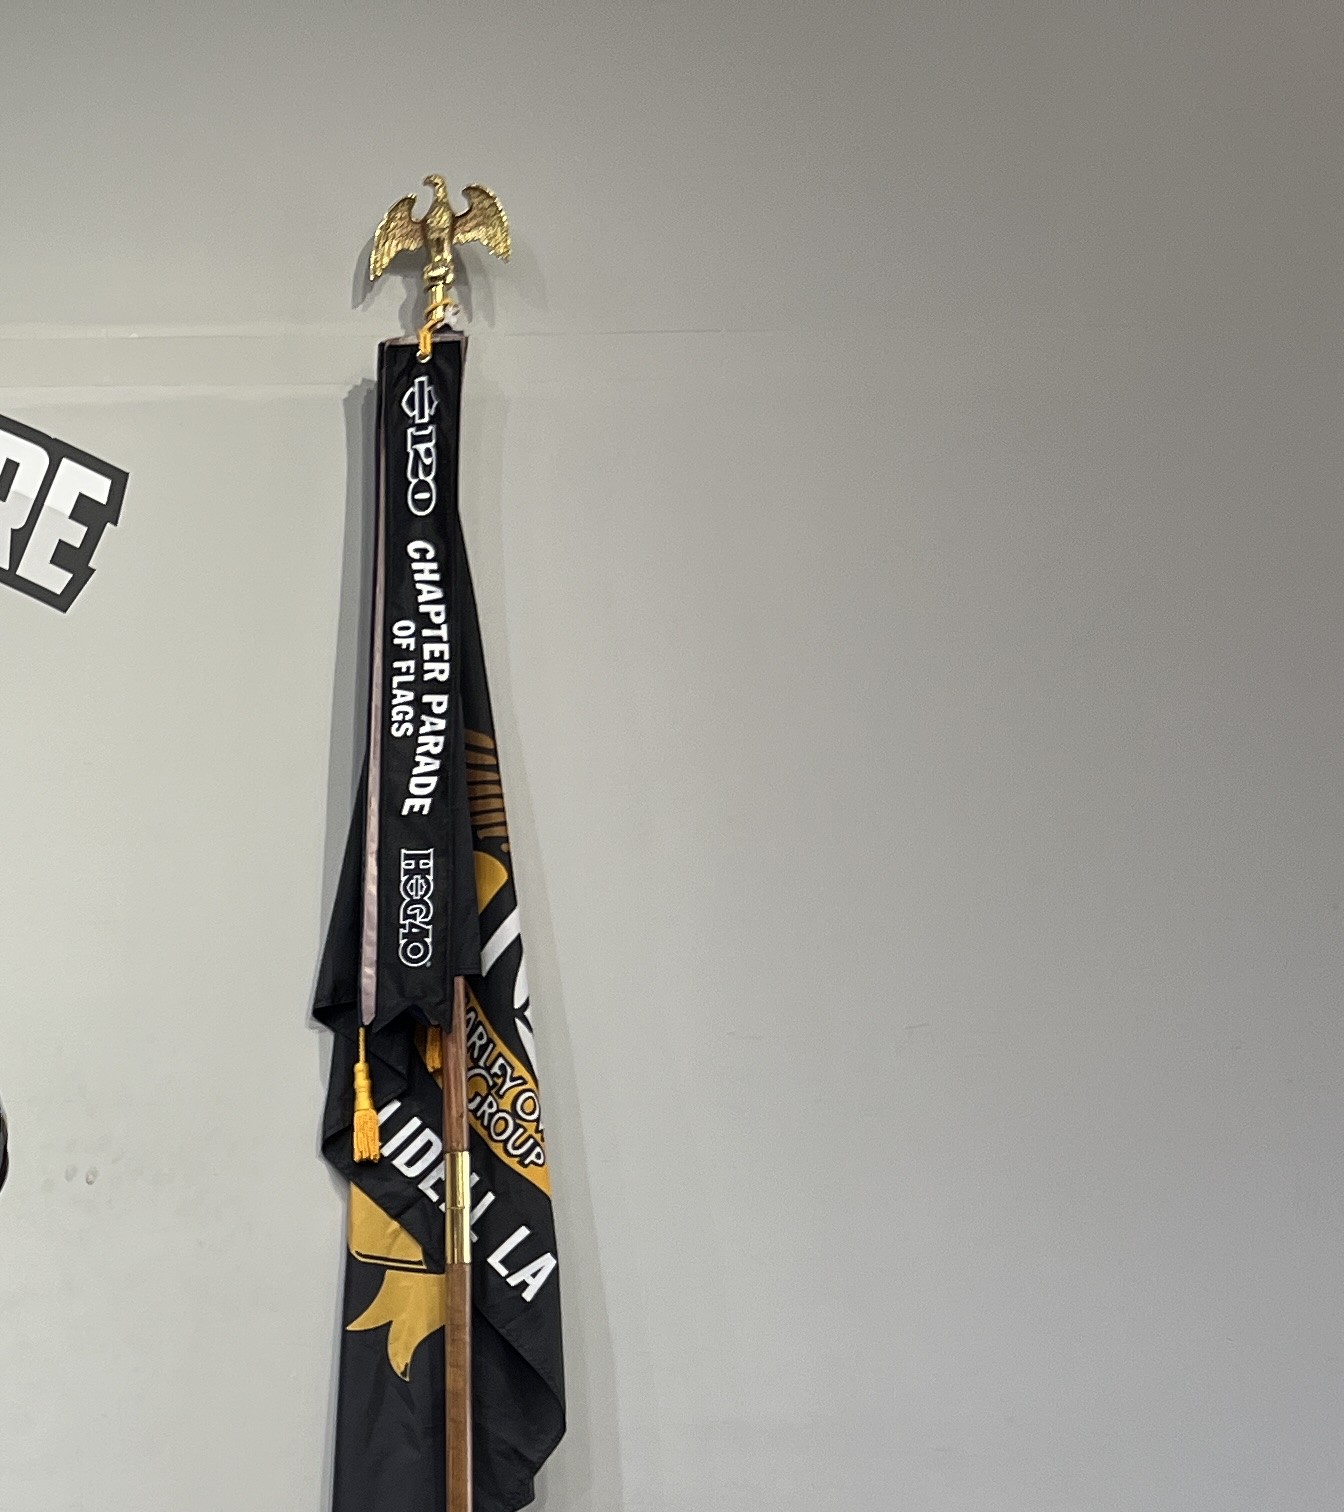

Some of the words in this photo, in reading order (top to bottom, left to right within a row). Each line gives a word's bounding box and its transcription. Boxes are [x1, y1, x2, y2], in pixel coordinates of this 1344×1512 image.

[406, 424, 437, 516] 120
[392, 619, 416, 651] OF
[406, 540, 450, 681] CHAPTER
[390, 659, 416, 738] FLAGS
[401, 694, 449, 816] PARADE
[465, 1010, 526, 1096] ARLEY
[466, 1067, 546, 1167] GROUP
[486, 1225, 558, 1303] LA
